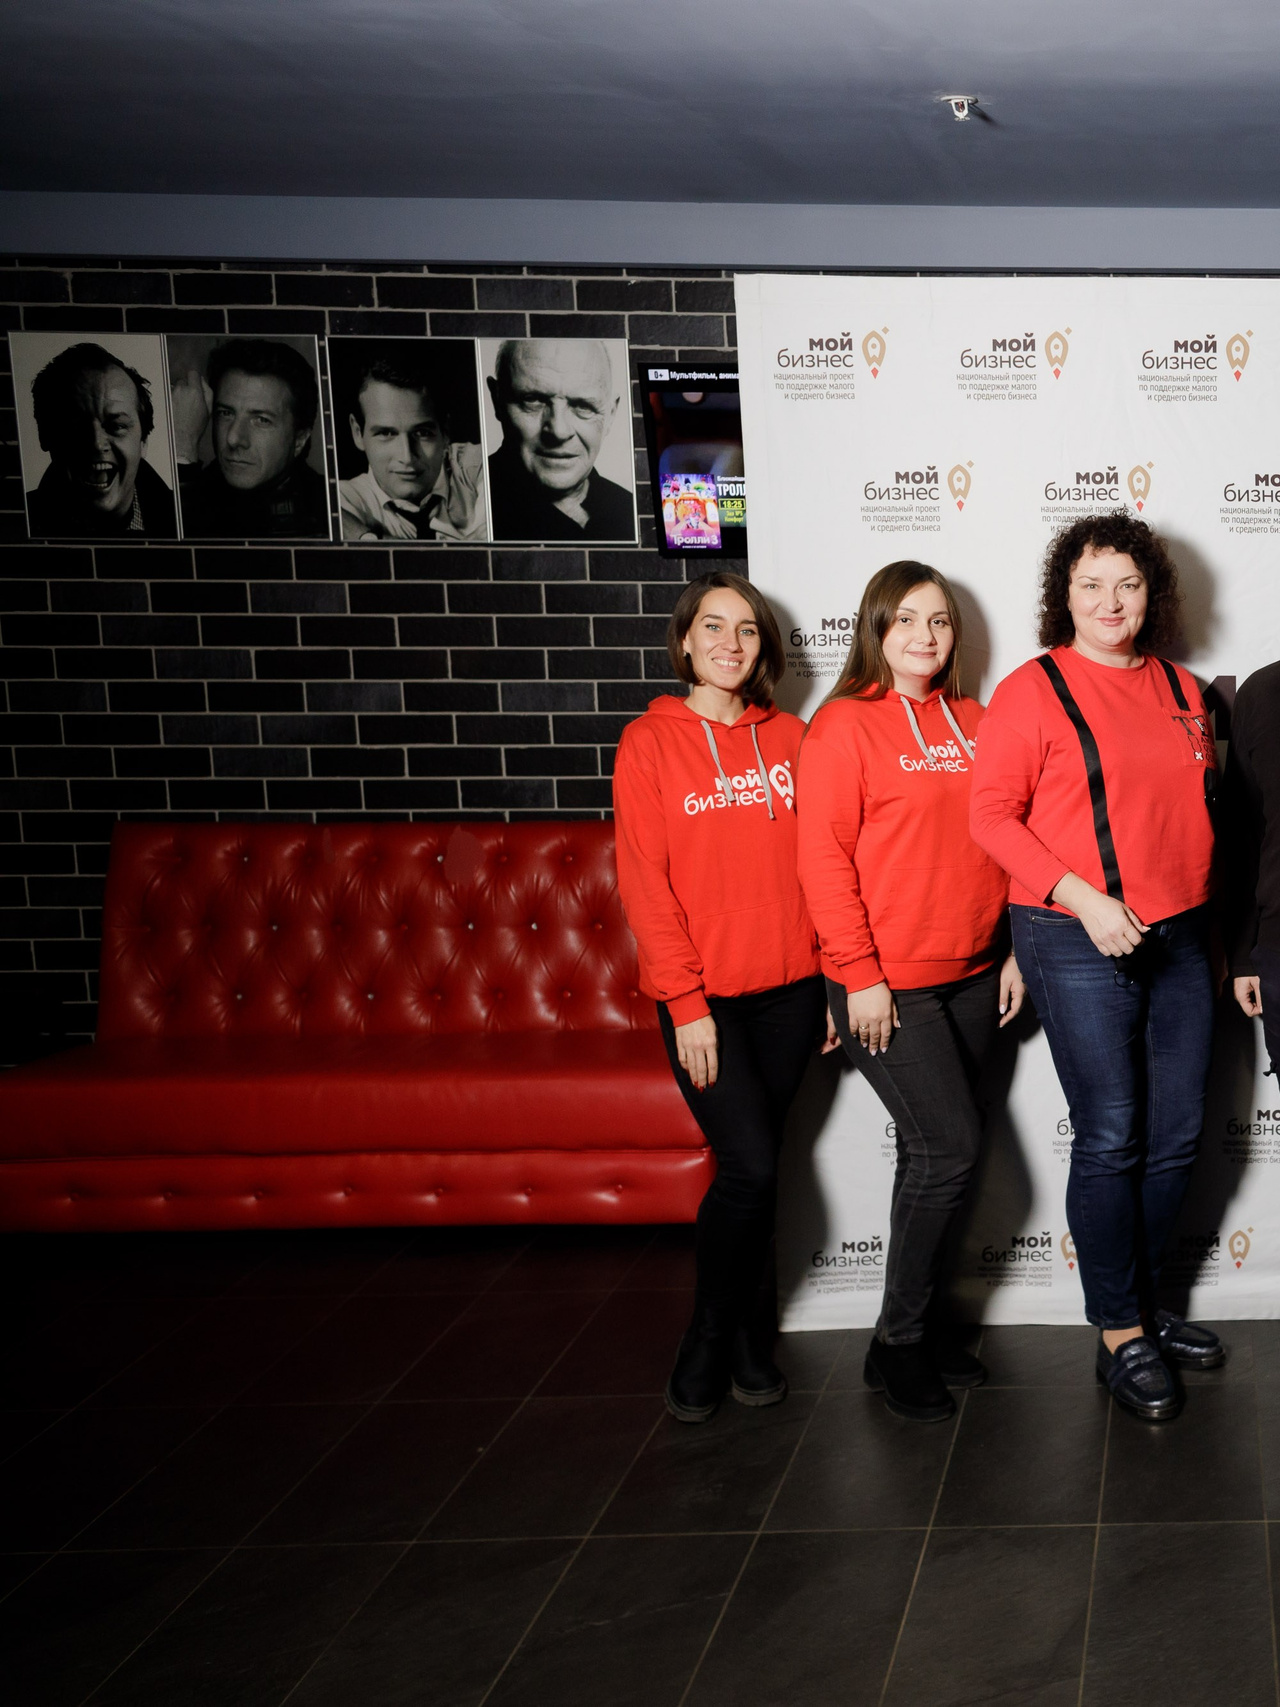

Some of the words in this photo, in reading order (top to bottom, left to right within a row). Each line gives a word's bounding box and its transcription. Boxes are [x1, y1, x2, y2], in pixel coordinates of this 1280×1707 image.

[809, 332, 852, 351] мой
[992, 333, 1035, 351] мой
[1174, 334, 1216, 353] мой
[777, 348, 853, 367] бизнес
[961, 349, 1036, 368] бизнес
[1142, 350, 1217, 369] бизнес
[774, 372, 827, 381] национальный
[829, 373, 854, 381] проект
[956, 372, 1009, 381] национальный
[1138, 374, 1190, 382] национальный
[1193, 375, 1217, 383] проект
[786, 383, 826, 391] поддержке
[969, 384, 1009, 392] поддержке
[1150, 385, 1189, 393] поддержке
[791, 393, 824, 401] среднего
[826, 391, 855, 399] бизнеса
[973, 393, 1006, 401] среднего
[1008, 392, 1037, 400] бизнеса
[1188, 393, 1217, 401] бизнеса
[895, 466, 938, 484] мой
[1076, 466, 1118, 485] мой
[864, 481, 939, 500] бизнес
[1044, 481, 1120, 501] бизнес
[723, 500, 742, 508] 18:25
[860, 504, 913, 513] национальный
[1040, 505, 1093, 513] национальный
[873, 515, 912, 523] поддержке
[1232, 517, 1271, 525] поддержке
[912, 523, 941, 531] бизнеса
[671, 534, 710, 546] Тролли
[711, 535, 719, 545] 3
[790, 628, 852, 646] бизне
[786, 651, 839, 659] национальный
[798, 661, 839, 669] поддержке
[803, 671, 836, 679] среднего
[842, 1236, 882, 1253] мой
[1012, 1232, 1052, 1248] мой
[812, 1250, 883, 1267] бизнес
[982, 1245, 1052, 1263] бизнес
